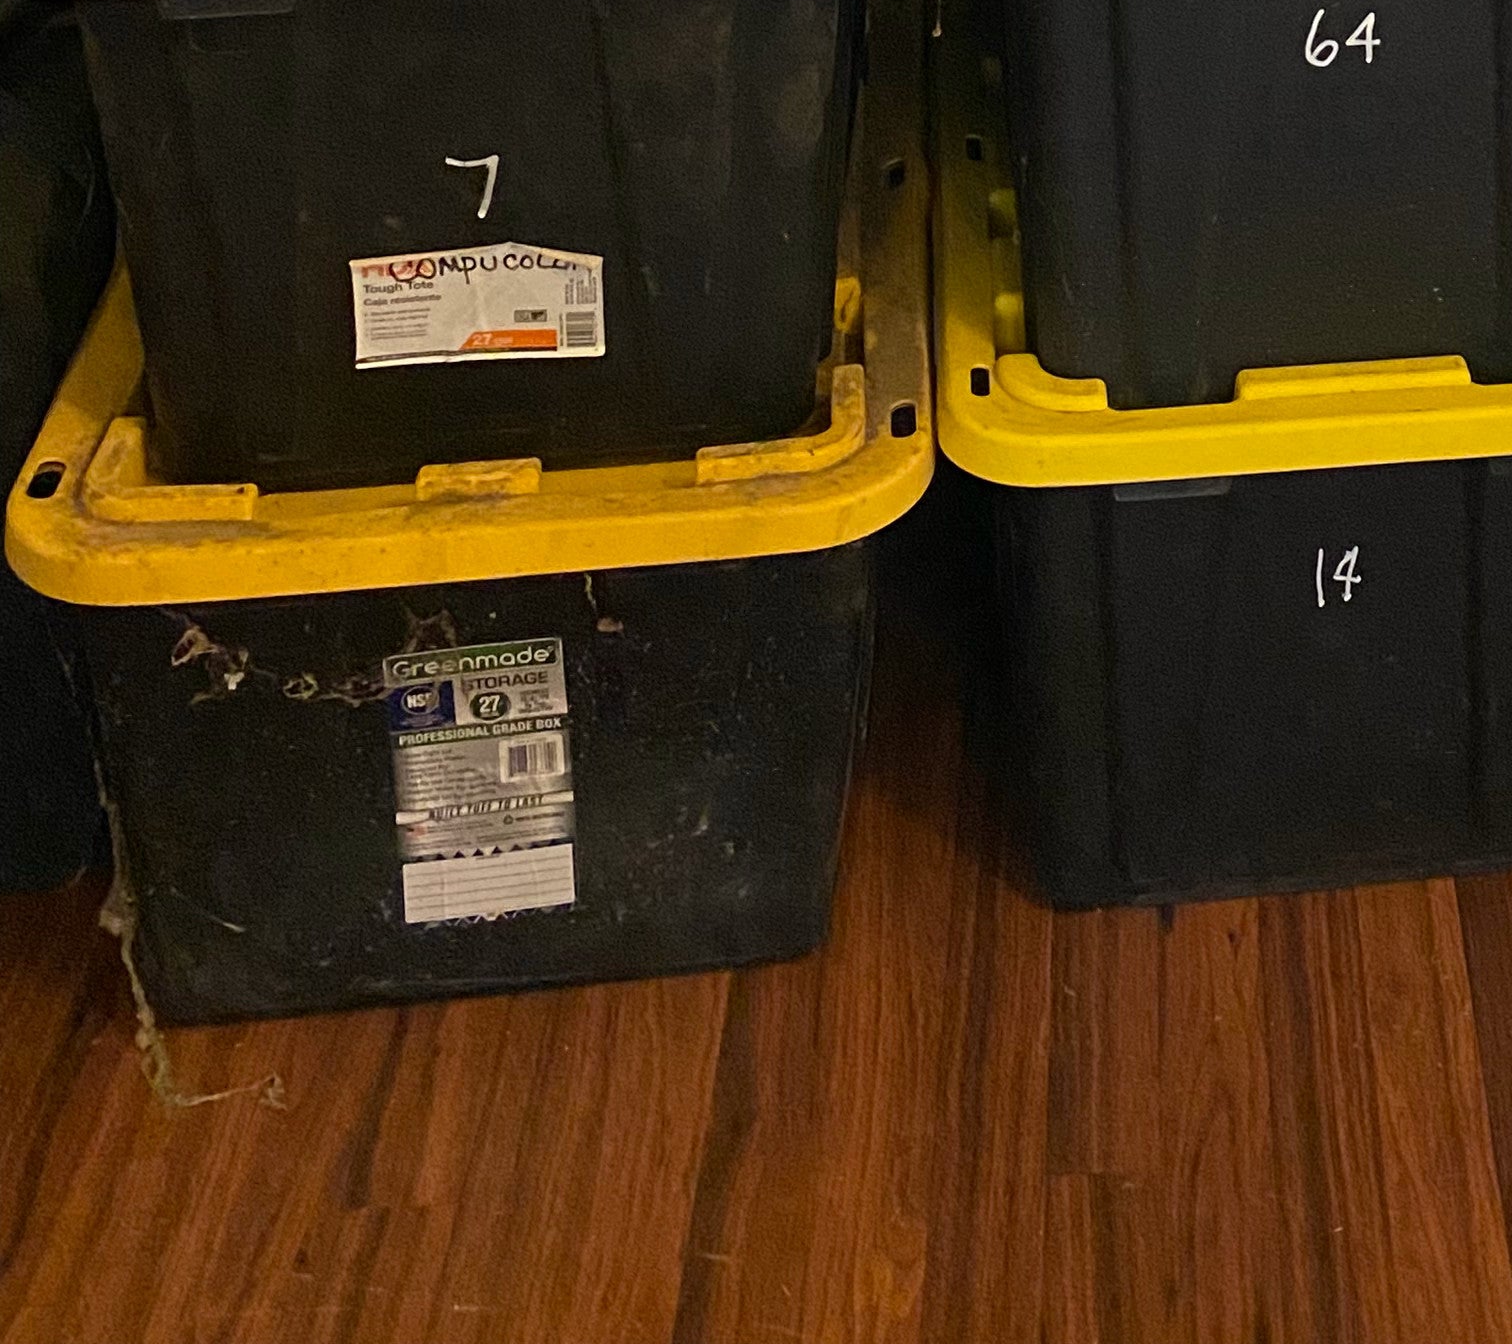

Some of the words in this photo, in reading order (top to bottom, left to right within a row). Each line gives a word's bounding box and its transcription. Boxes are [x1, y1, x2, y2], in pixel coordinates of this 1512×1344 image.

[1305, 9, 1381, 67] 64
[445, 154, 499, 219] 7
[363, 283, 403, 294] Tough
[408, 281, 434, 291] Tote
[472, 332, 493, 346] 27
[1316, 545, 1362, 607] 14
[392, 646, 550, 677] Greenmade
[461, 670, 549, 691] STORAGE
[478, 695, 501, 713] 27
[398, 726, 490, 746] PROFESSIONAL
[492, 720, 534, 736] GRADE
[536, 717, 562, 729] BOX
